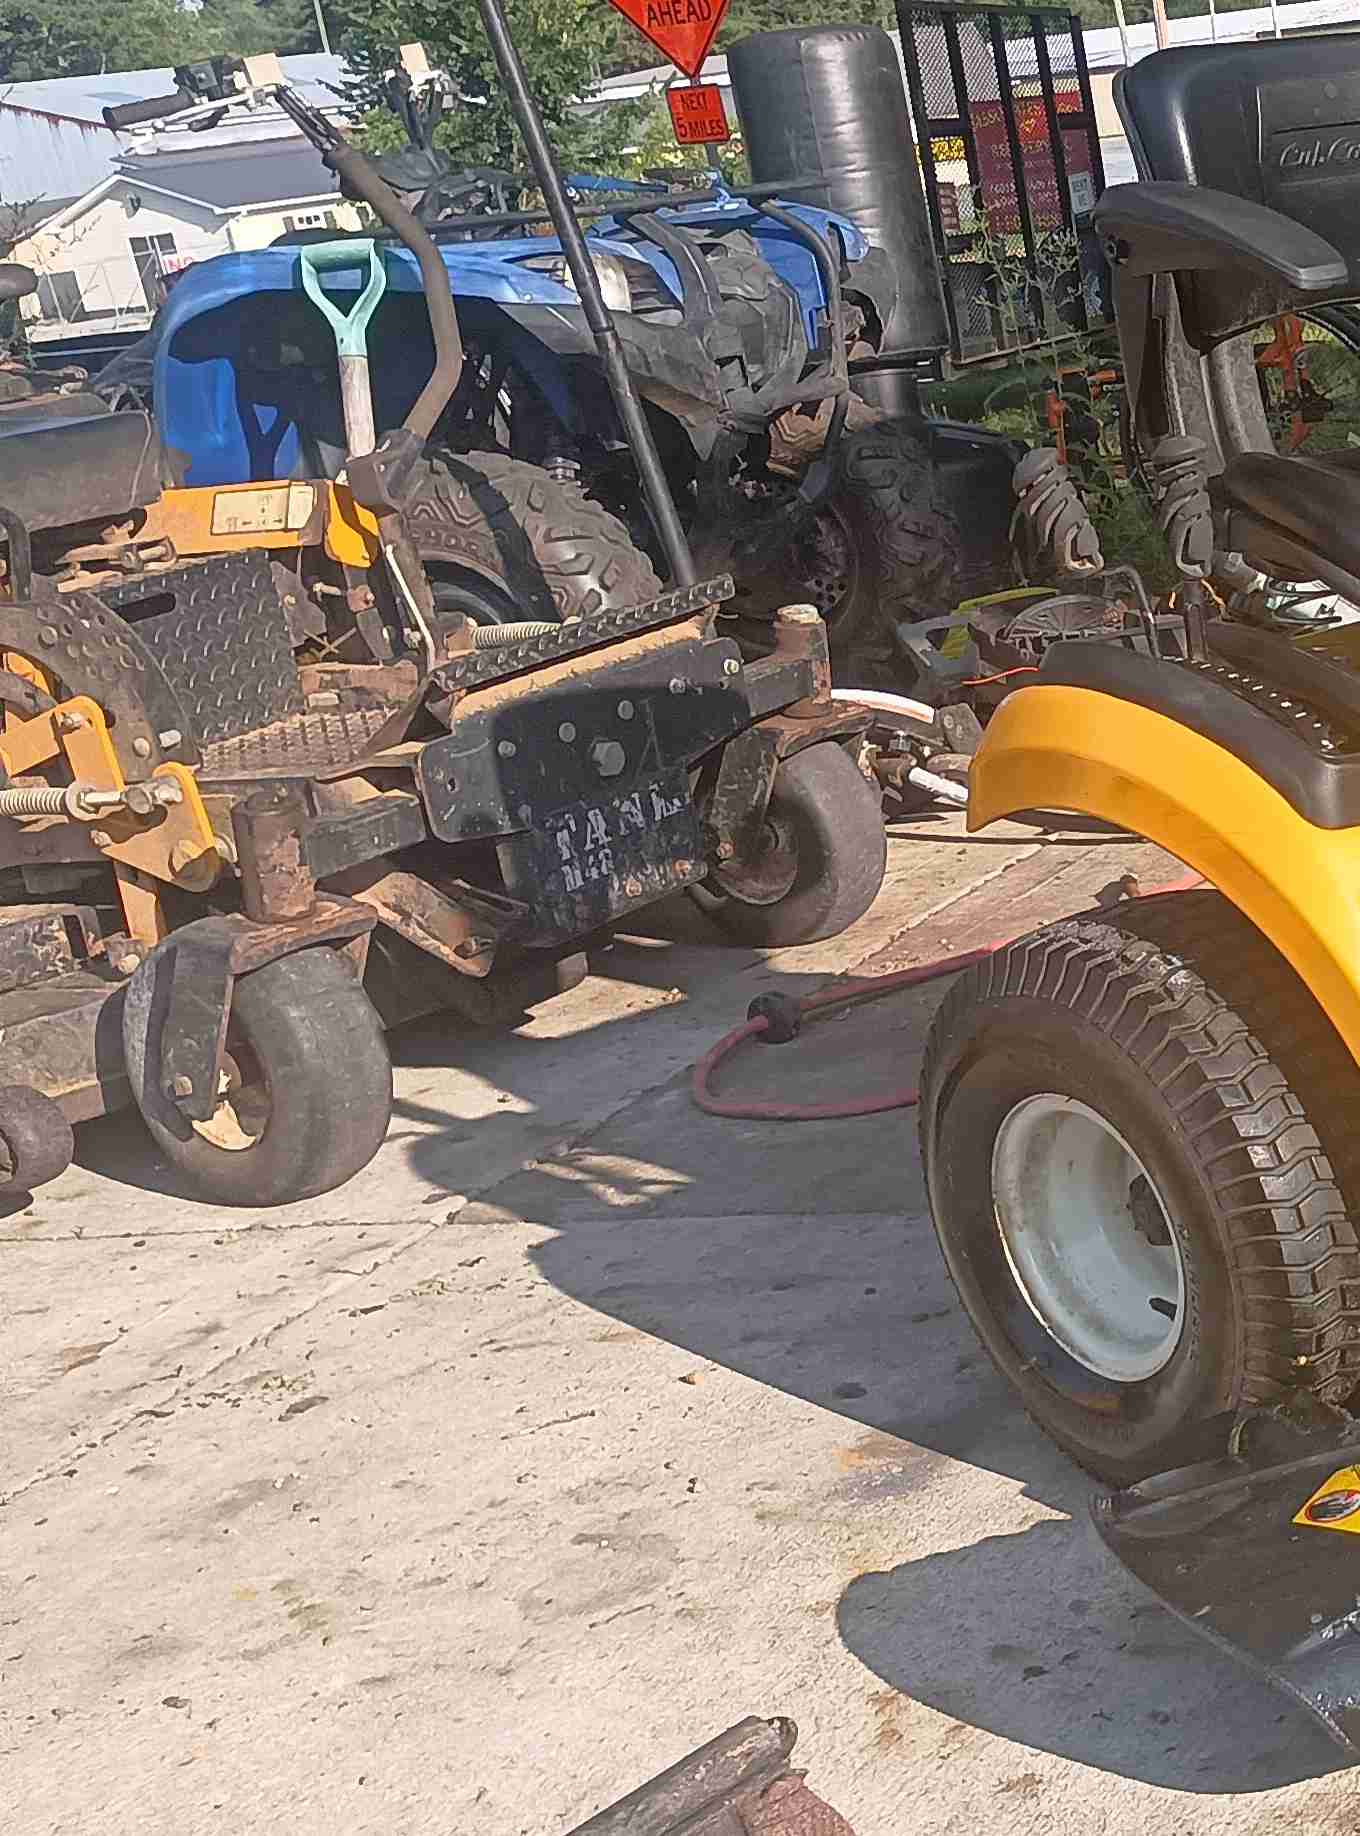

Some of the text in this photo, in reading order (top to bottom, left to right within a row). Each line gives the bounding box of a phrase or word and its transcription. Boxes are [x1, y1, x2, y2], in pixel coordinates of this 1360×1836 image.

[647, 0, 711, 27] AHEAD
[680, 91, 708, 112] NEXT
[676, 117, 725, 138] 5 MILES
